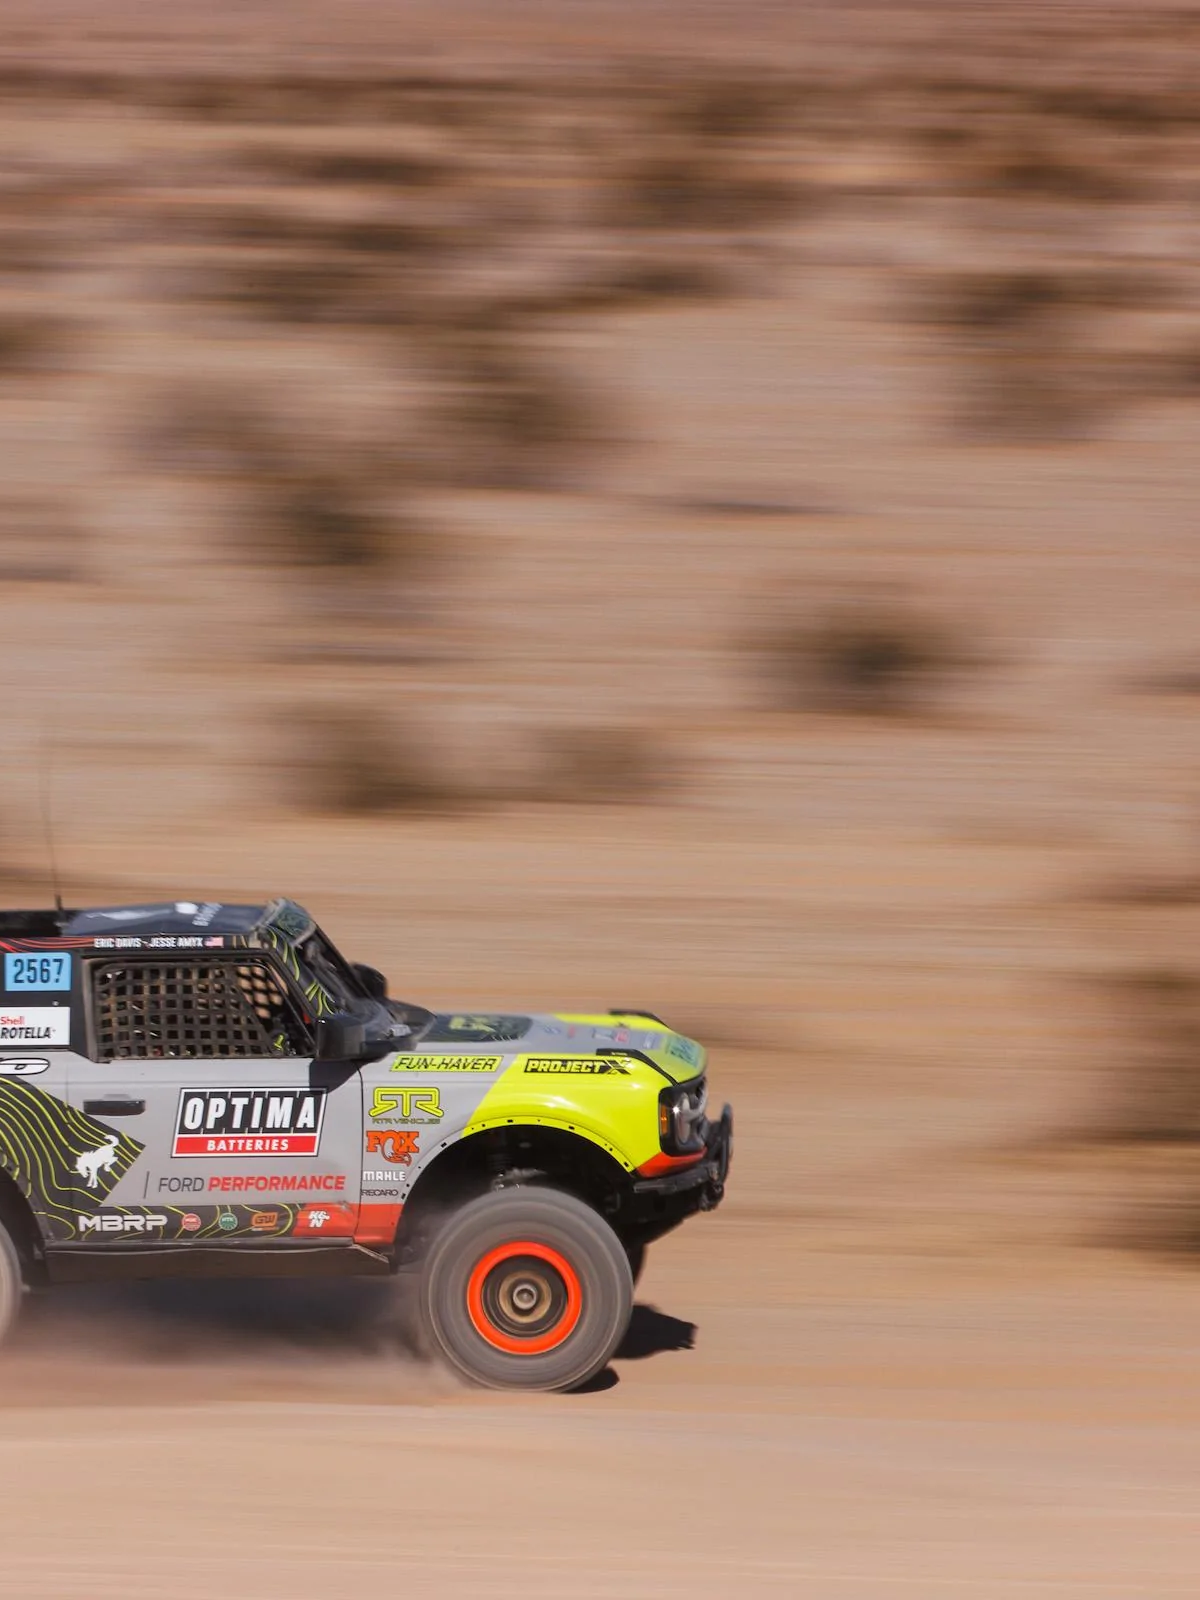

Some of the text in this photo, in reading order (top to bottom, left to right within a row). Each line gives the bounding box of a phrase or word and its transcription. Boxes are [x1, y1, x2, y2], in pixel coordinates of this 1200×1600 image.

[94, 938, 114, 948] ERIC
[115, 937, 141, 948] DAVIS
[150, 937, 176, 947] JESSE
[177, 937, 203, 947] AMYX
[13, 958, 64, 983] 2567
[0, 1016, 25, 1025] Shell
[0, 1027, 51, 1039] ROTELLA
[395, 1057, 497, 1071] FUN-HAVER
[183, 1096, 316, 1131] OPTIMA
[207, 1139, 289, 1151] BATTERIES
[366, 1130, 420, 1166] FOX
[363, 1171, 406, 1181] MAHLE
[158, 1176, 346, 1192] FORD PERFORMANCE
[361, 1189, 399, 1197] RECARO
[78, 1215, 168, 1232] MBRP
